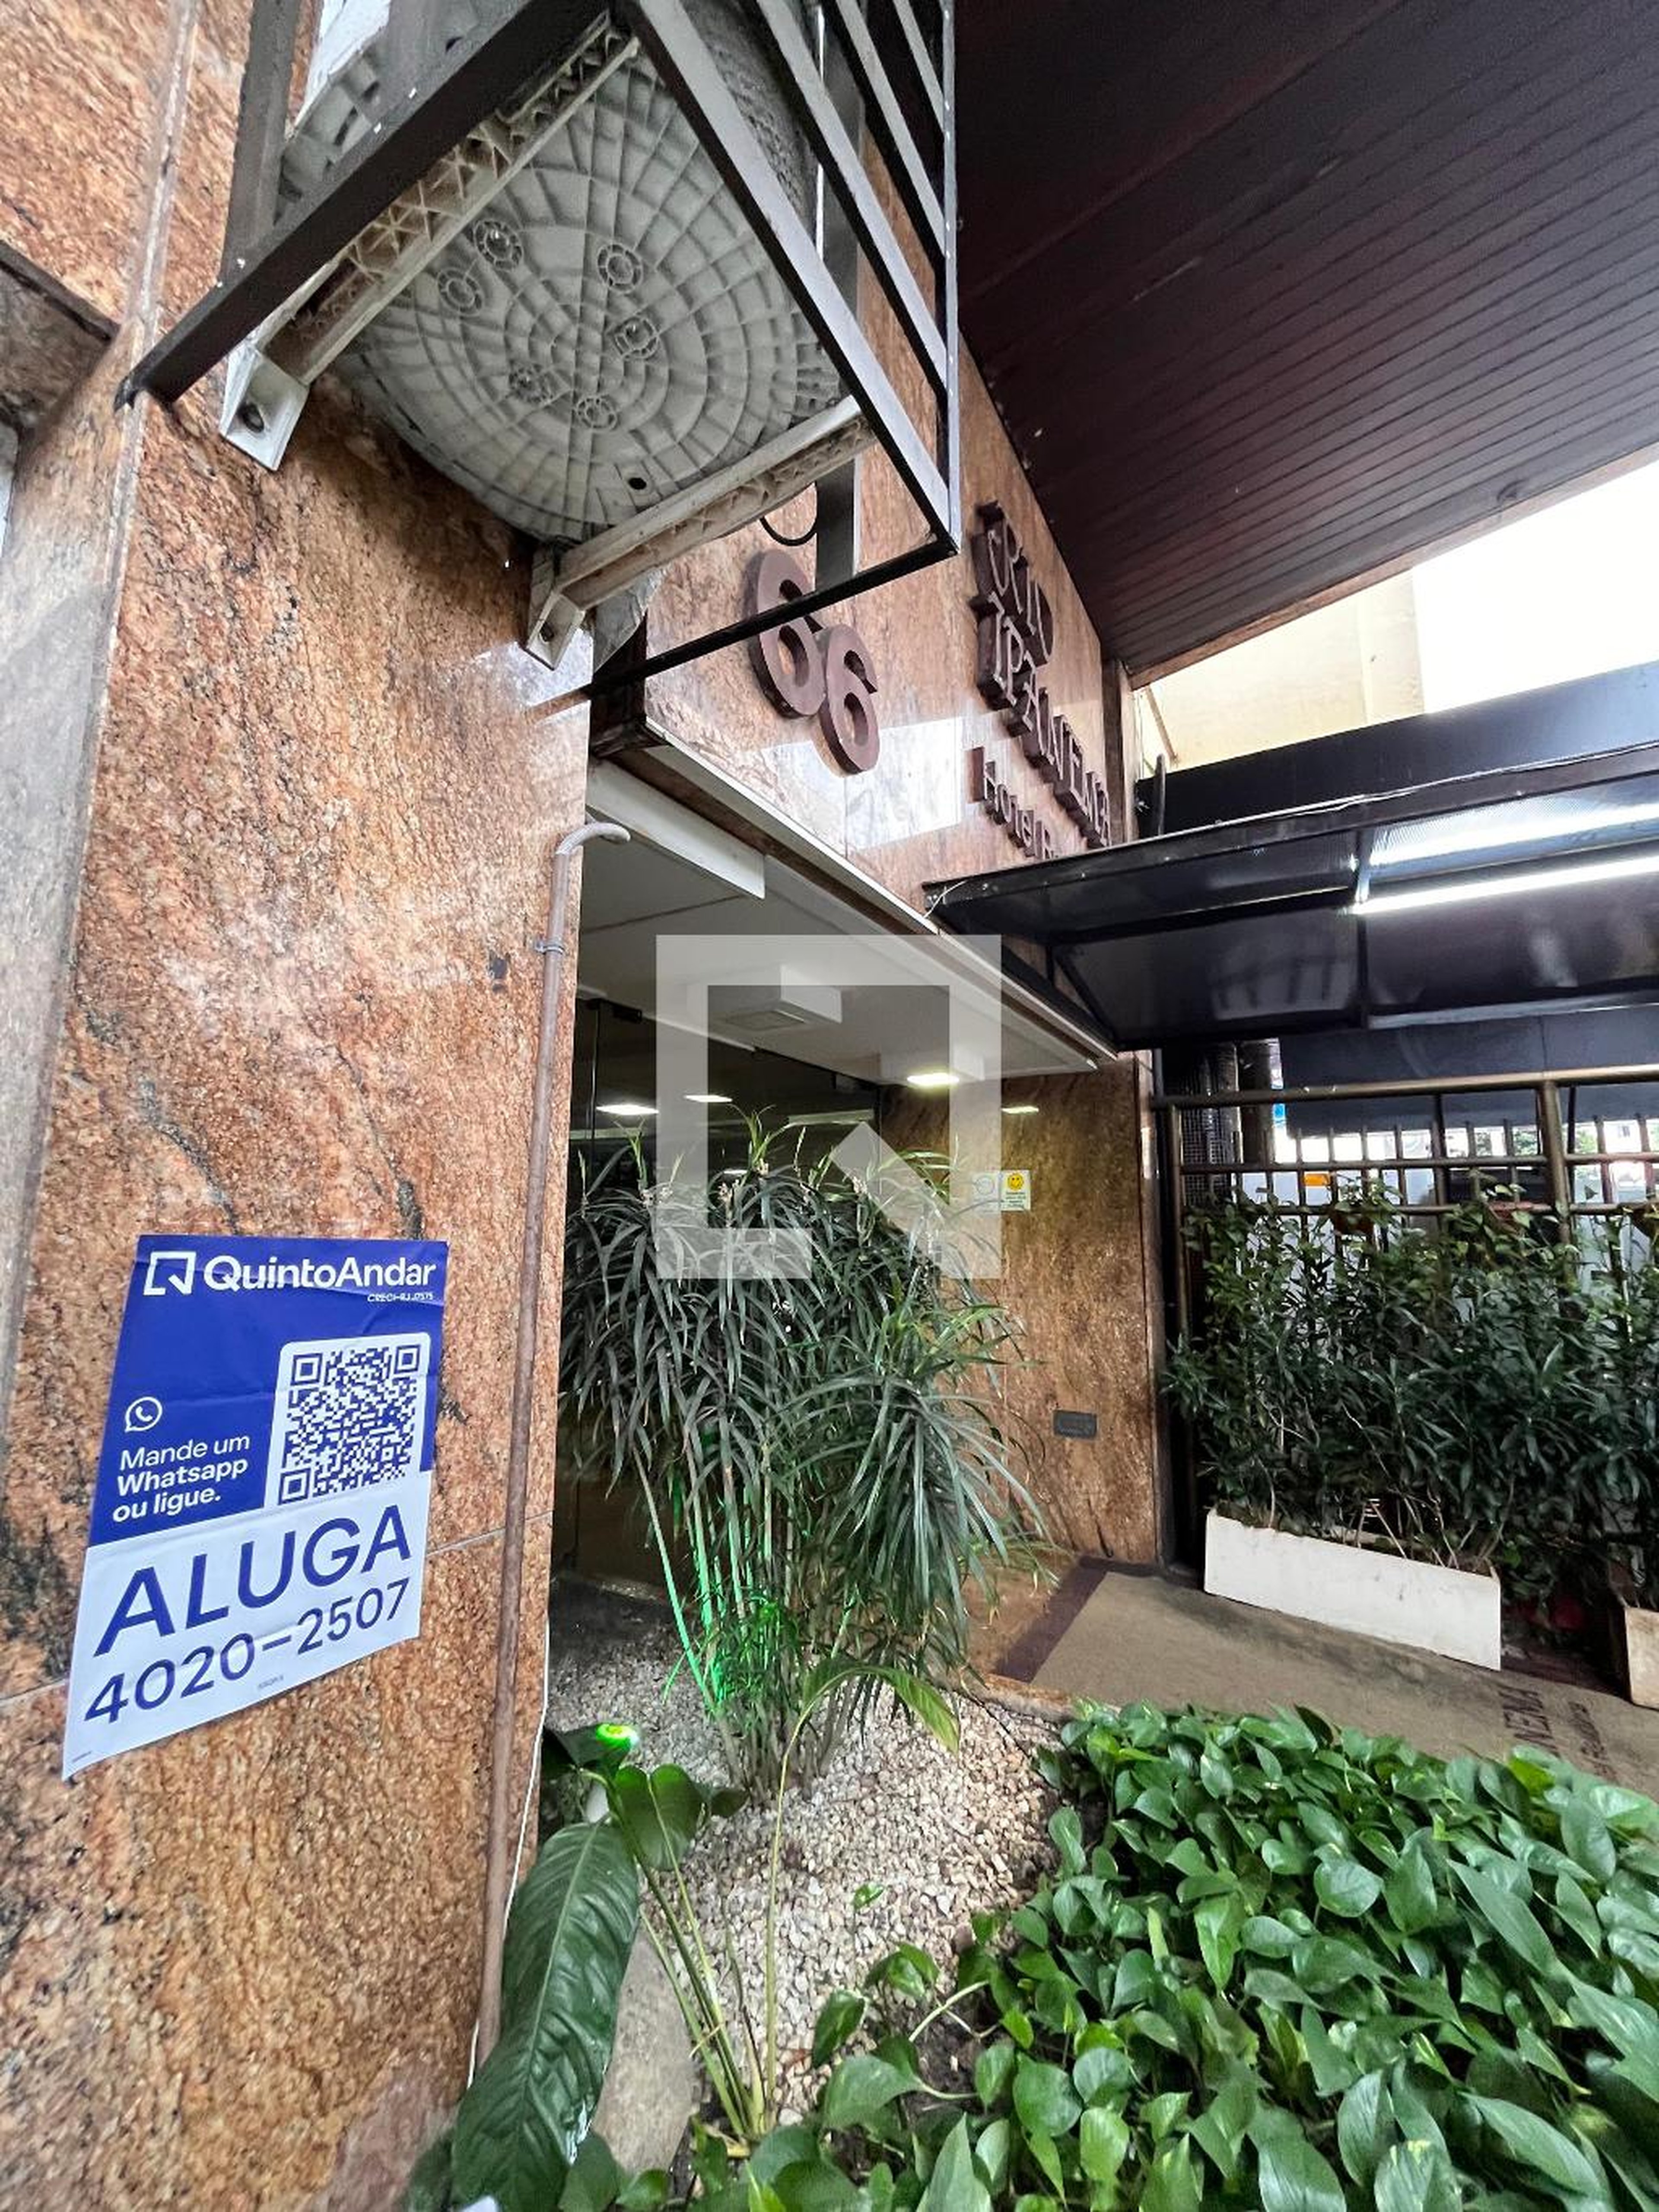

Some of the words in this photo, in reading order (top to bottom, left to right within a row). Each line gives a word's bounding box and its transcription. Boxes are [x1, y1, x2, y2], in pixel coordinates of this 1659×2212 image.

[747, 549, 880, 775] 66
[979, 590, 1111, 848] IPANEMA
[203, 1255, 436, 1292] QuintoAndar
[117, 1458, 248, 1496] Whatsapp
[120, 1439, 208, 1471] Mande
[213, 1435, 250, 1455] um
[112, 1501, 148, 1522] ou
[153, 1487, 221, 1515] ligue.
[93, 1504, 411, 1657] ALUGA
[84, 1578, 410, 1723] 4020-2507
